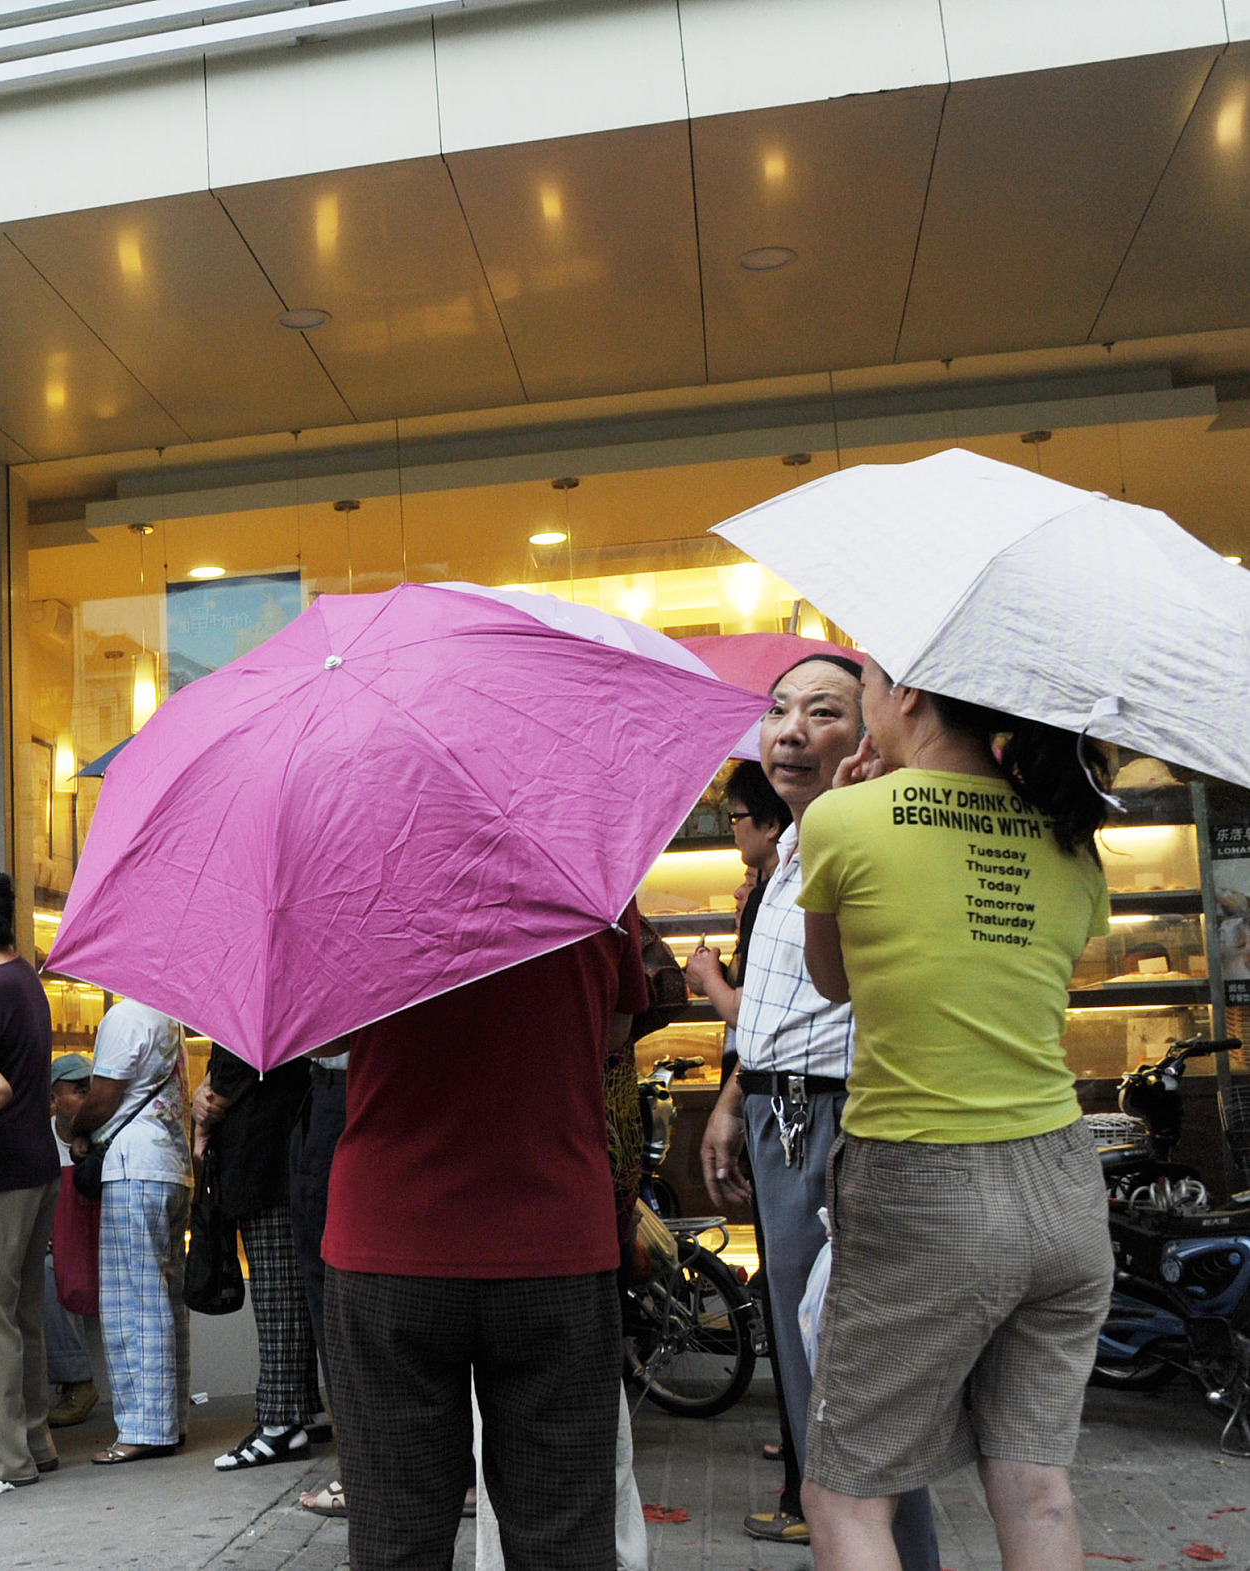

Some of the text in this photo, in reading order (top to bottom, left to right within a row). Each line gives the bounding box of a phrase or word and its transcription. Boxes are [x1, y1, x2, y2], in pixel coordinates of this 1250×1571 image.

[893, 789, 897, 802] I
[903, 787, 953, 806] ONLY
[957, 791, 1008, 813] DRINK
[893, 806, 994, 834] BEGINNING
[997, 817, 1042, 838] WITH
[968, 844, 1027, 863] Tuesday
[965, 859, 1031, 879] Thursday
[978, 878, 1021, 895] Today
[965, 895, 1036, 912] Tomorrow
[966, 911, 1036, 931] Thaturday
[970, 930, 1032, 948] Thunday.
